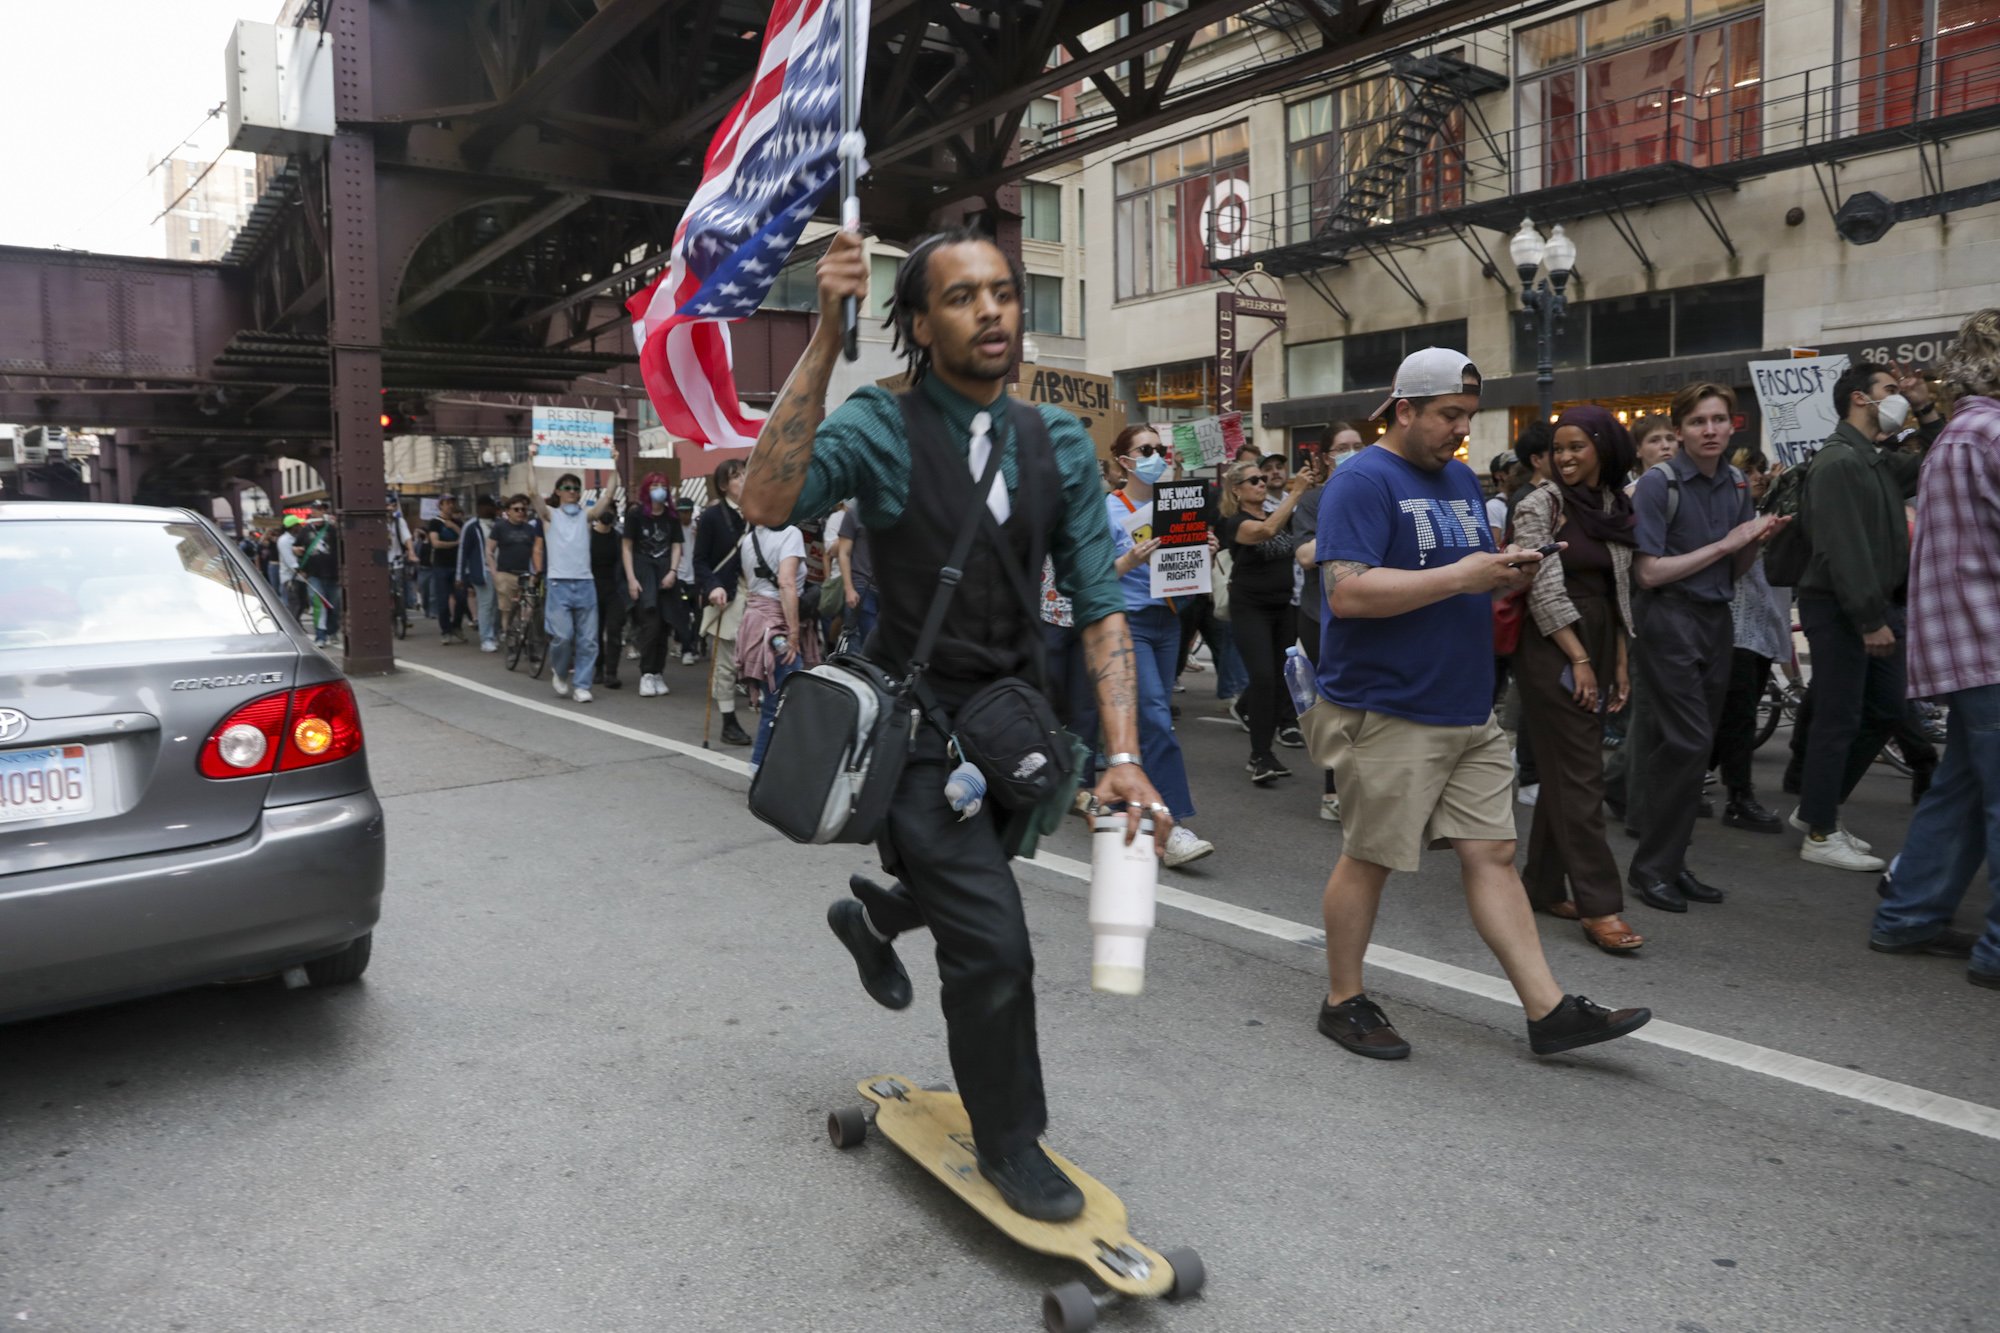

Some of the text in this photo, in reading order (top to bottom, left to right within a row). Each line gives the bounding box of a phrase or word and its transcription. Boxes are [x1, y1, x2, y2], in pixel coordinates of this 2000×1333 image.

[1235, 298, 1270, 311] EWELERS
[1861, 339, 1955, 365] 36 SOU
[1220, 310, 1233, 412] AVENUE
[1756, 365, 1824, 396] FASCIST
[1030, 370, 1109, 410] ABOLISH
[547, 409, 596, 424] RESIST
[548, 424, 599, 438] FACISM
[547, 439, 600, 453] ABOLISH
[563, 453, 587, 466] ICE
[1159, 485, 1203, 500] WE WON'T
[1157, 496, 1205, 511] BE DIVIDED
[1181, 511, 1198, 521] NOT
[1169, 521, 1207, 533] ONE MORE
[1161, 532, 1208, 545] EPORTATION
[1161, 550, 1201, 563] UNITE FOR
[1157, 559, 1204, 572] IMMIGRANT
[1166, 570, 1196, 581] RIGHTS
[170, 671, 284, 691] COROLLA LE
